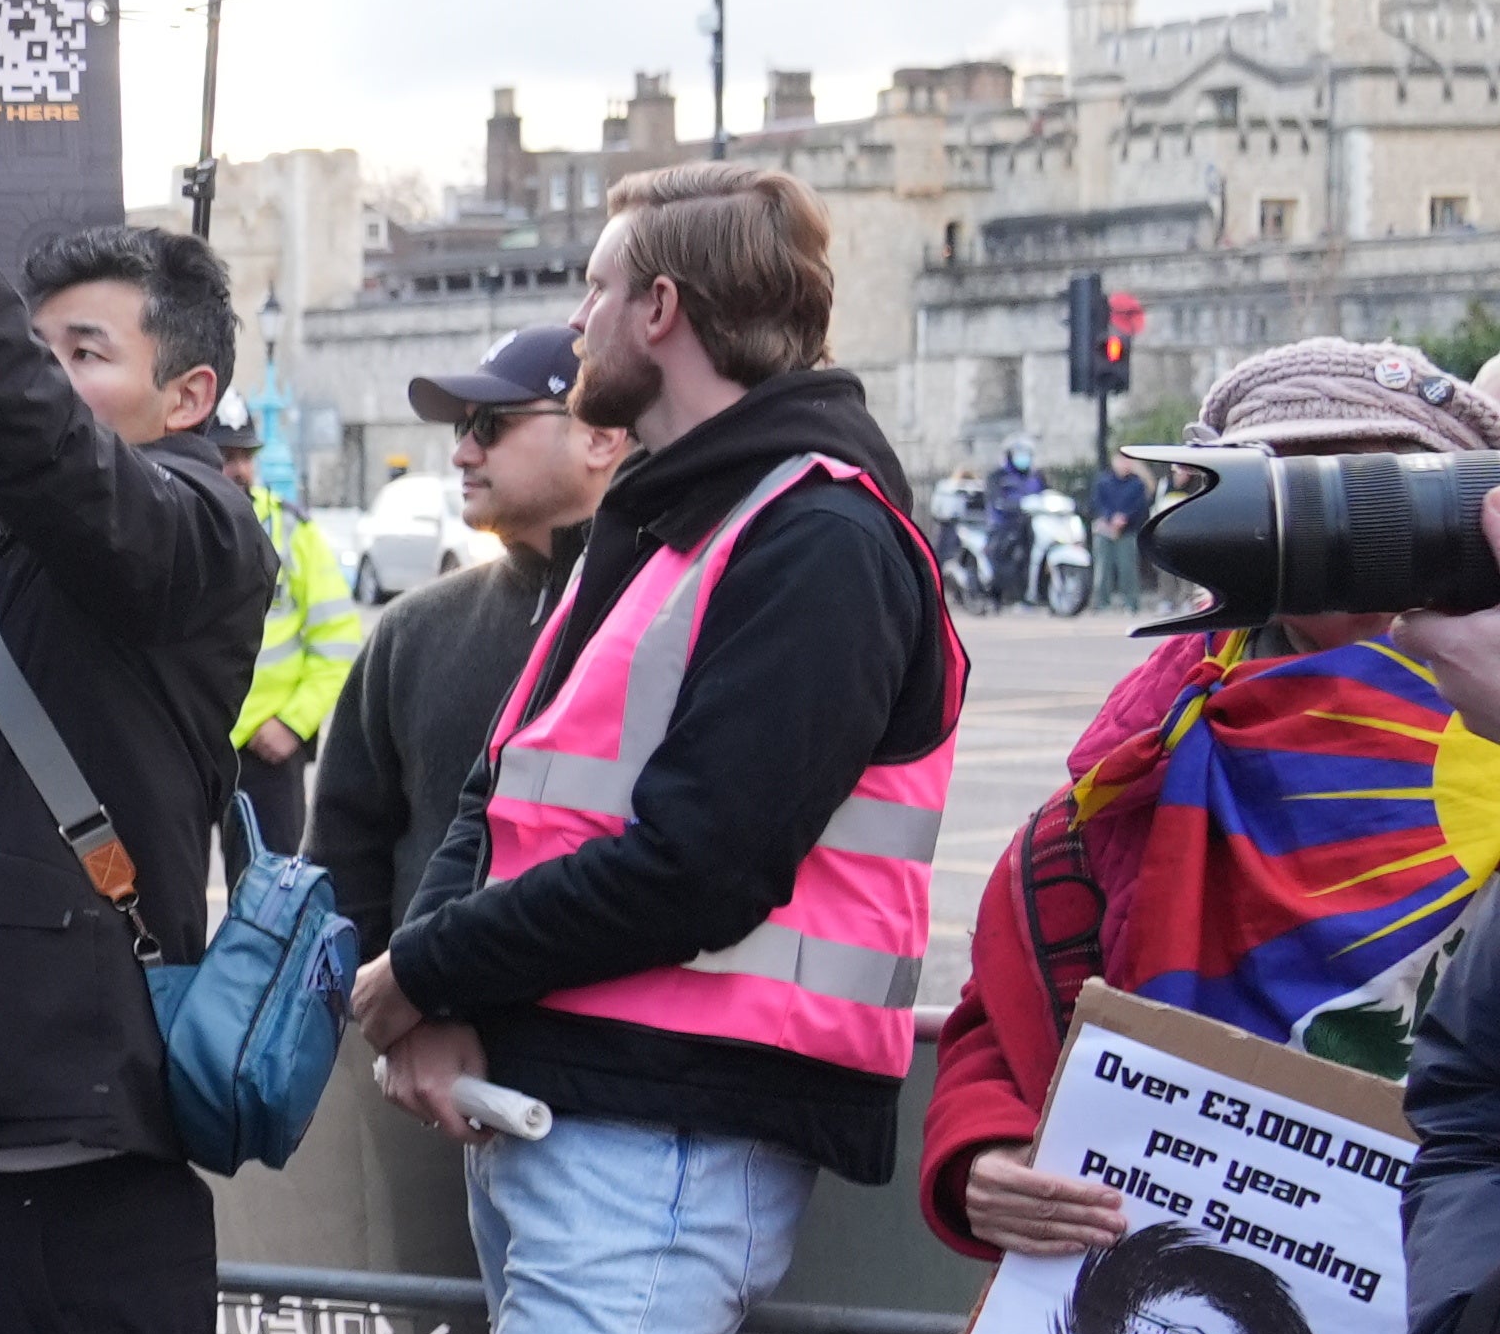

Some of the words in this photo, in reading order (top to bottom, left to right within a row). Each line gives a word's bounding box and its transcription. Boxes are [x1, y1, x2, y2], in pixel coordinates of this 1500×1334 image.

[6, 103, 80, 122] HERE
[1094, 1050, 1189, 1106] Over
[1144, 1129, 1218, 1179] per
[1222, 1159, 1321, 1209] year
[1080, 1149, 1192, 1218] Police
[1201, 1200, 1382, 1304] Spending
